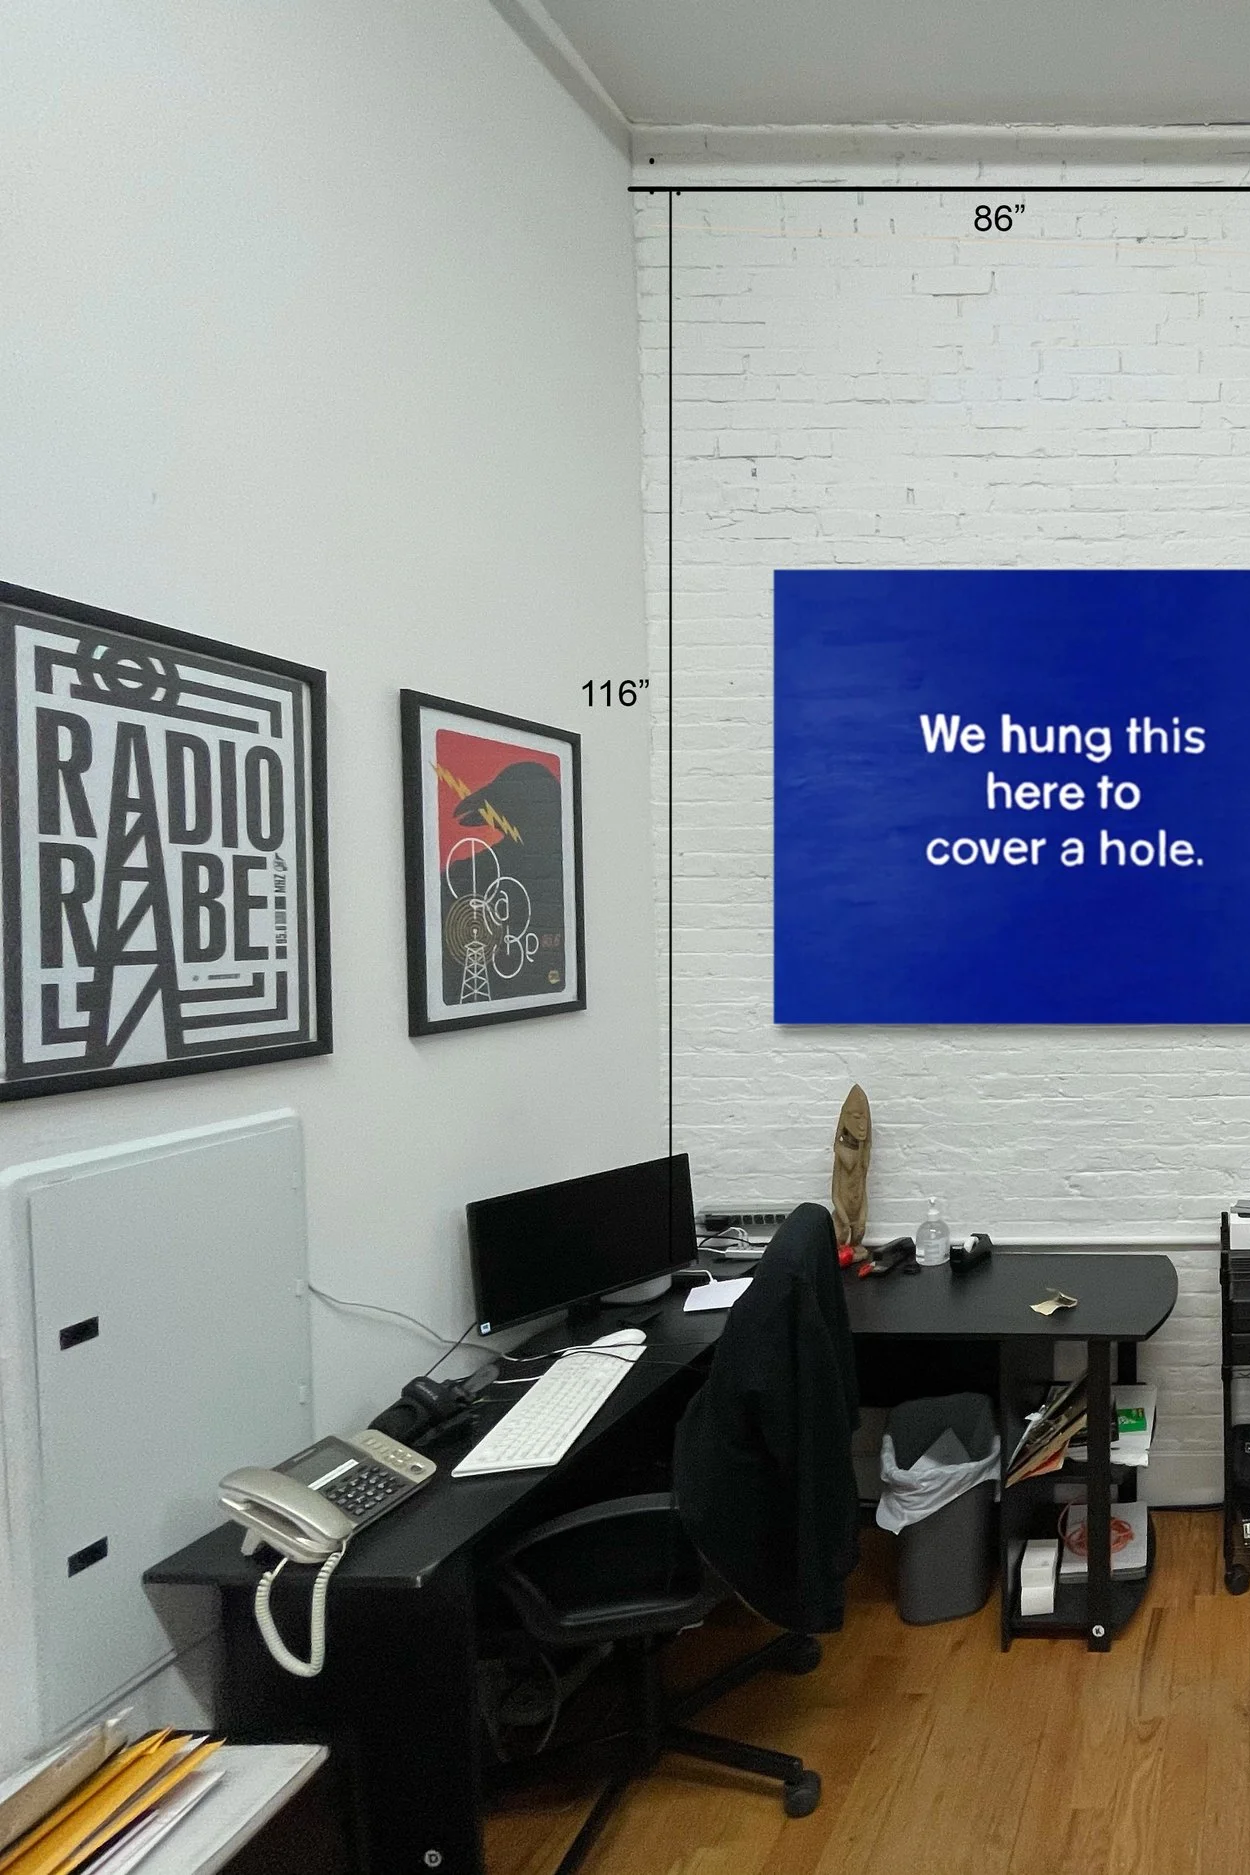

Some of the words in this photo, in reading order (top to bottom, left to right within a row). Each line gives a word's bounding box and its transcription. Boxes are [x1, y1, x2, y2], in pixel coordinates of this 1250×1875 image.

[920, 713, 986, 753] We
[1001, 713, 1112, 763] hung
[1126, 716, 1206, 754] this
[36, 706, 285, 853] RADIO
[986, 771, 1085, 810] here
[1097, 775, 1141, 810] to
[925, 837, 1047, 866] cover
[1060, 837, 1084, 867] a
[1100, 829, 1204, 867] hole.
[38, 842, 270, 971] RABE
